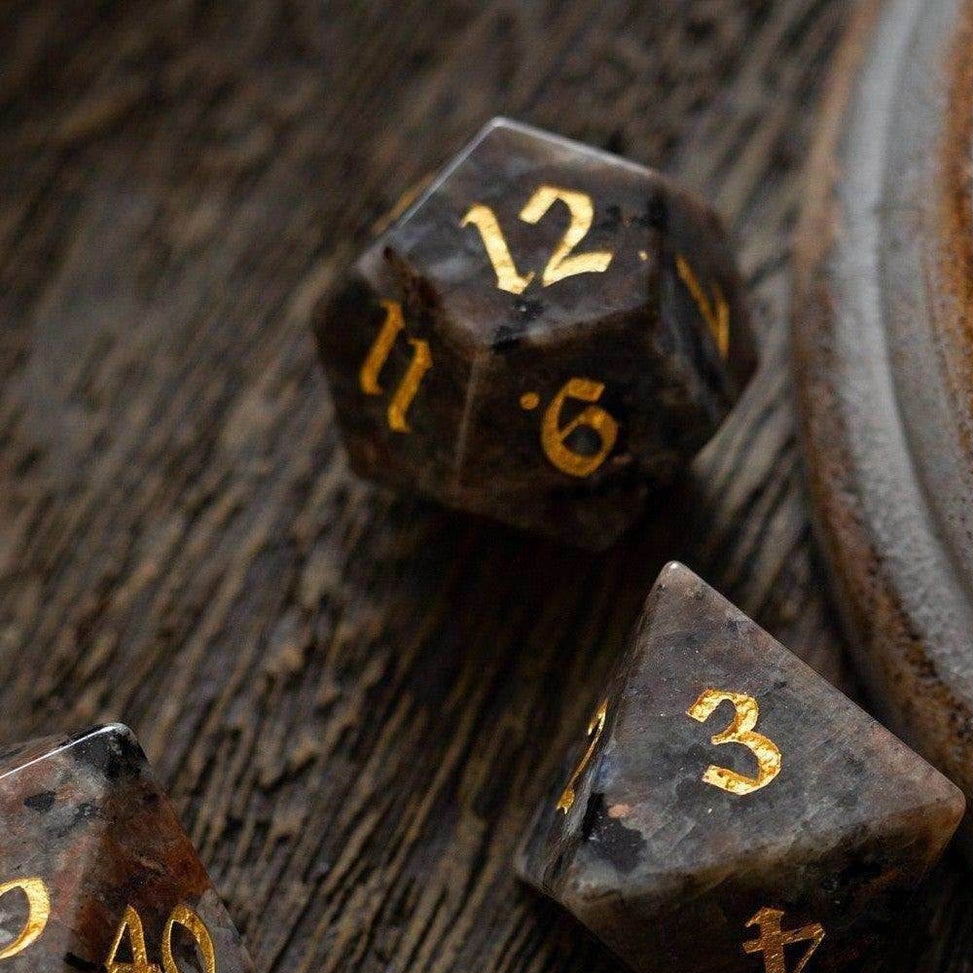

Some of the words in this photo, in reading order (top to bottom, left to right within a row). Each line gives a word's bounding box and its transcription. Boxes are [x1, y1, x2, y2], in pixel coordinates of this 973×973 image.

[459, 184, 614, 295] 12
[358, 300, 433, 433] 11
[686, 687, 783, 797] 3
